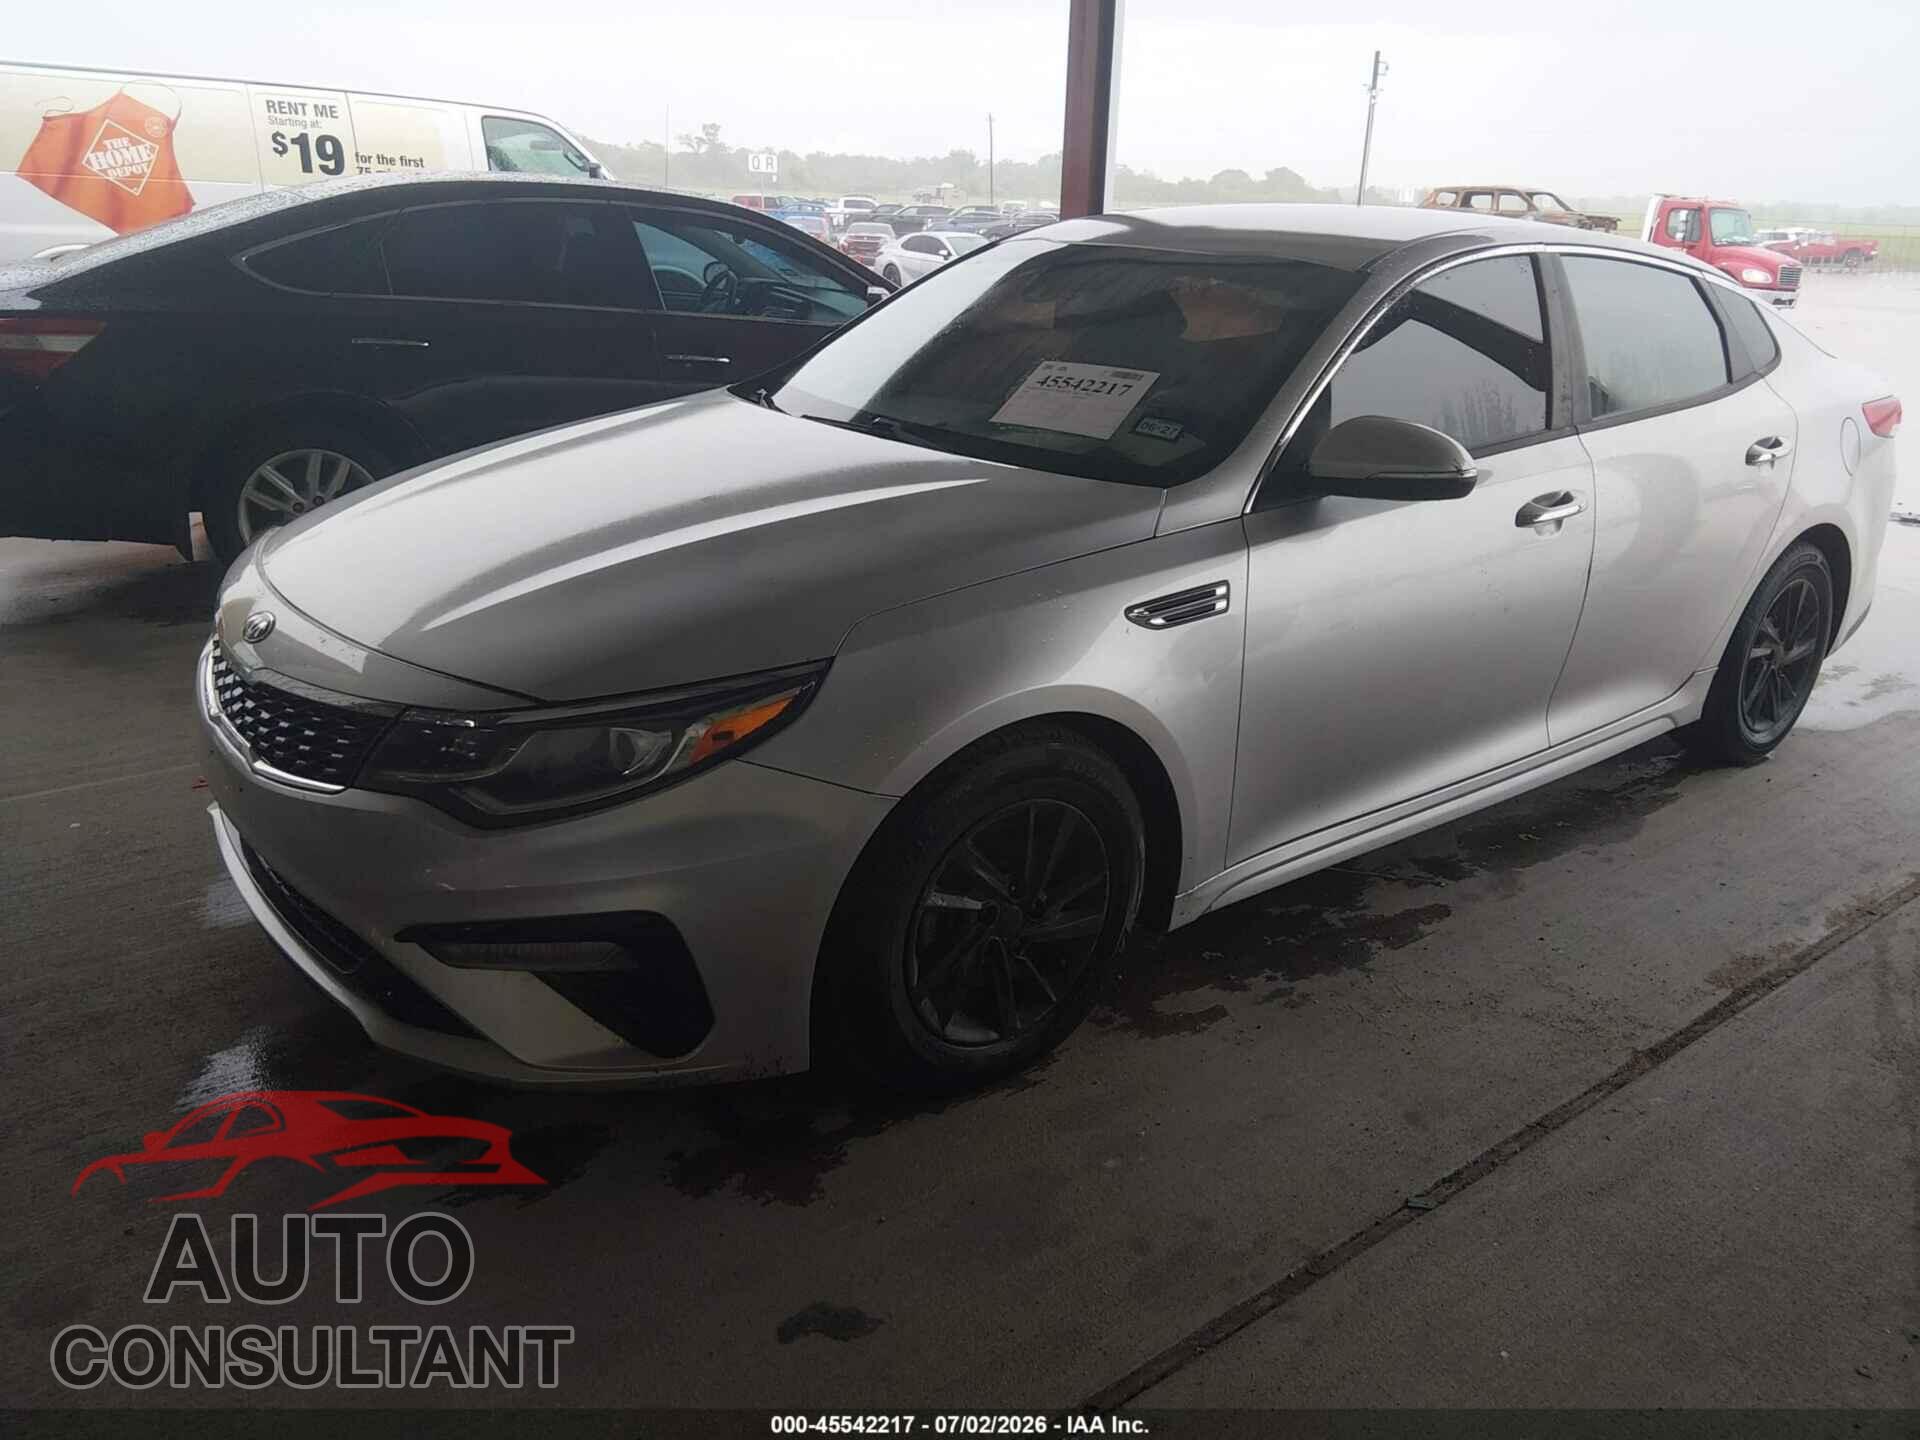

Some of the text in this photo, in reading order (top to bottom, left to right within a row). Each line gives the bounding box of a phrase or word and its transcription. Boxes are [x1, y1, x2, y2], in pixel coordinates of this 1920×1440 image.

[266, 99, 339, 119] RENT ME
[267, 115, 308, 129] Starting
[103, 137, 130, 150] THE
[88, 143, 155, 170] HOME
[271, 131, 345, 176] $19
[355, 152, 424, 168] for the first
[107, 162, 148, 177] DEPOT
[1036, 375, 1133, 396] 45542217
